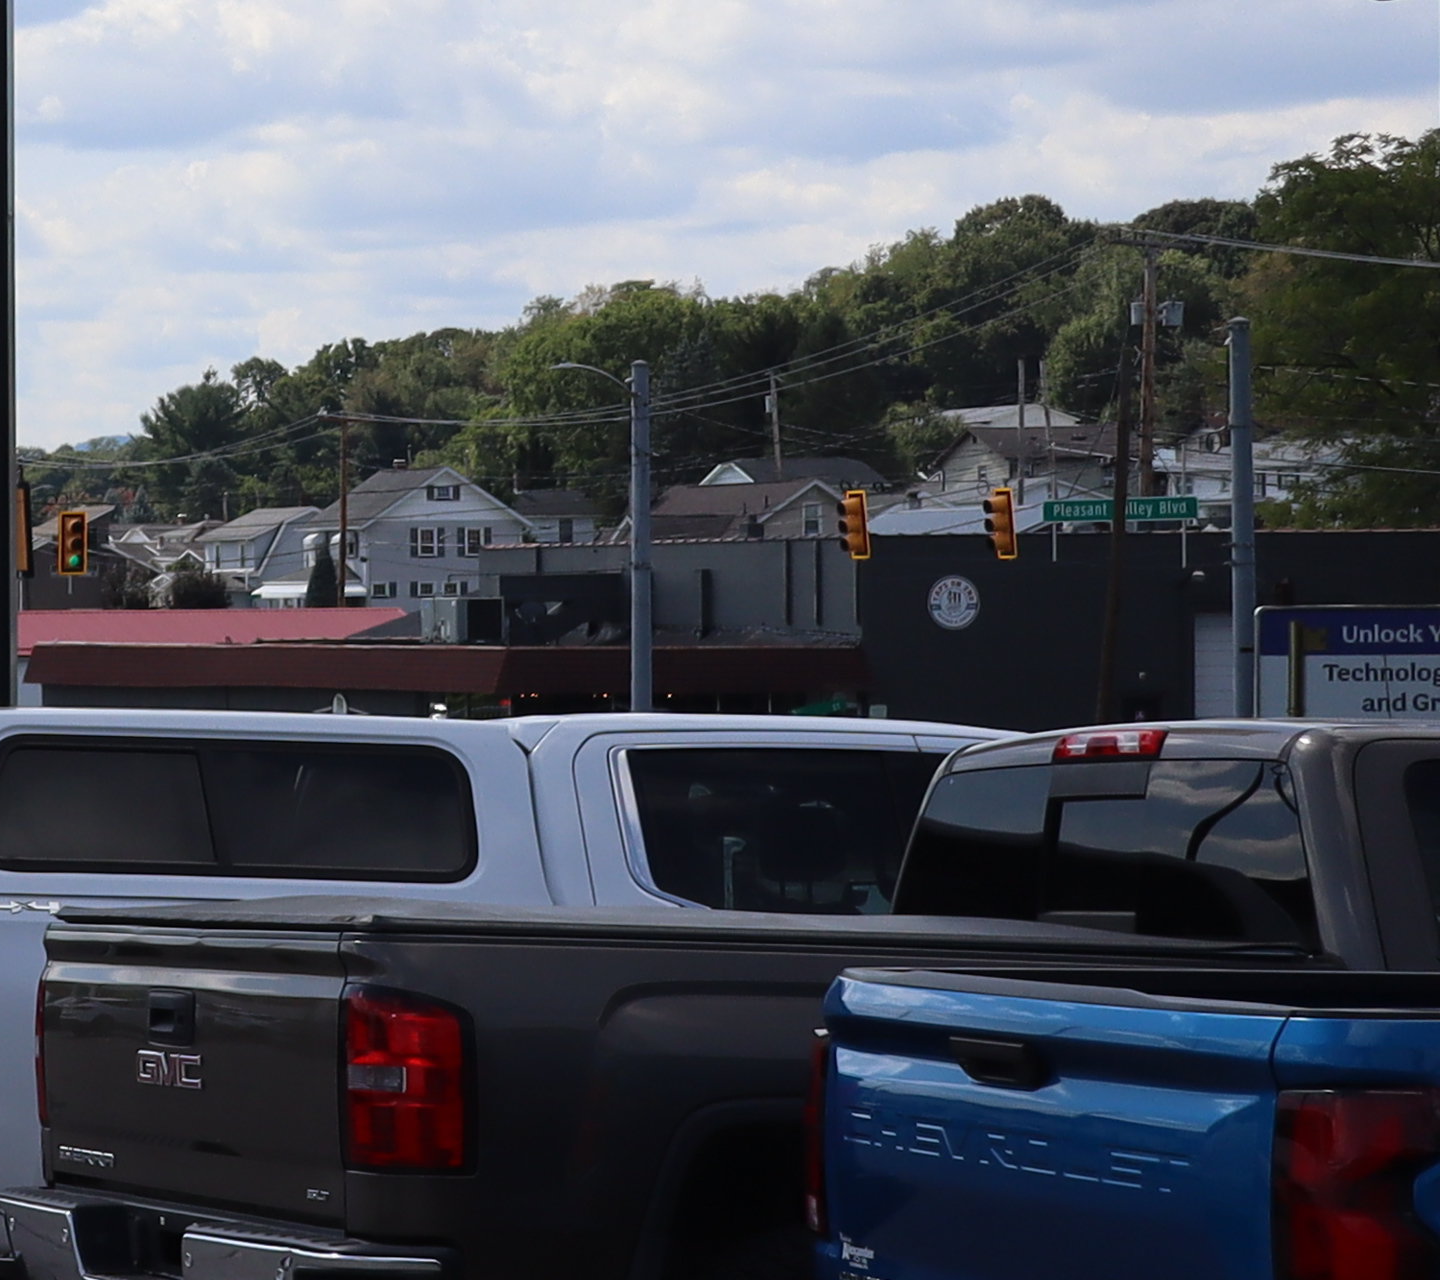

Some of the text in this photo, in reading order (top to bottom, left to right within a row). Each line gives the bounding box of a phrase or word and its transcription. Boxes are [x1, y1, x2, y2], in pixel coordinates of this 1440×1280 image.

[1053, 501, 1187, 518] Pleasant lley Blvd
[1341, 623, 1424, 643] Unlock
[1361, 691, 1407, 712] and
[137, 1049, 202, 1089] GMC
[843, 1110, 1191, 1193] CHEVROLET
